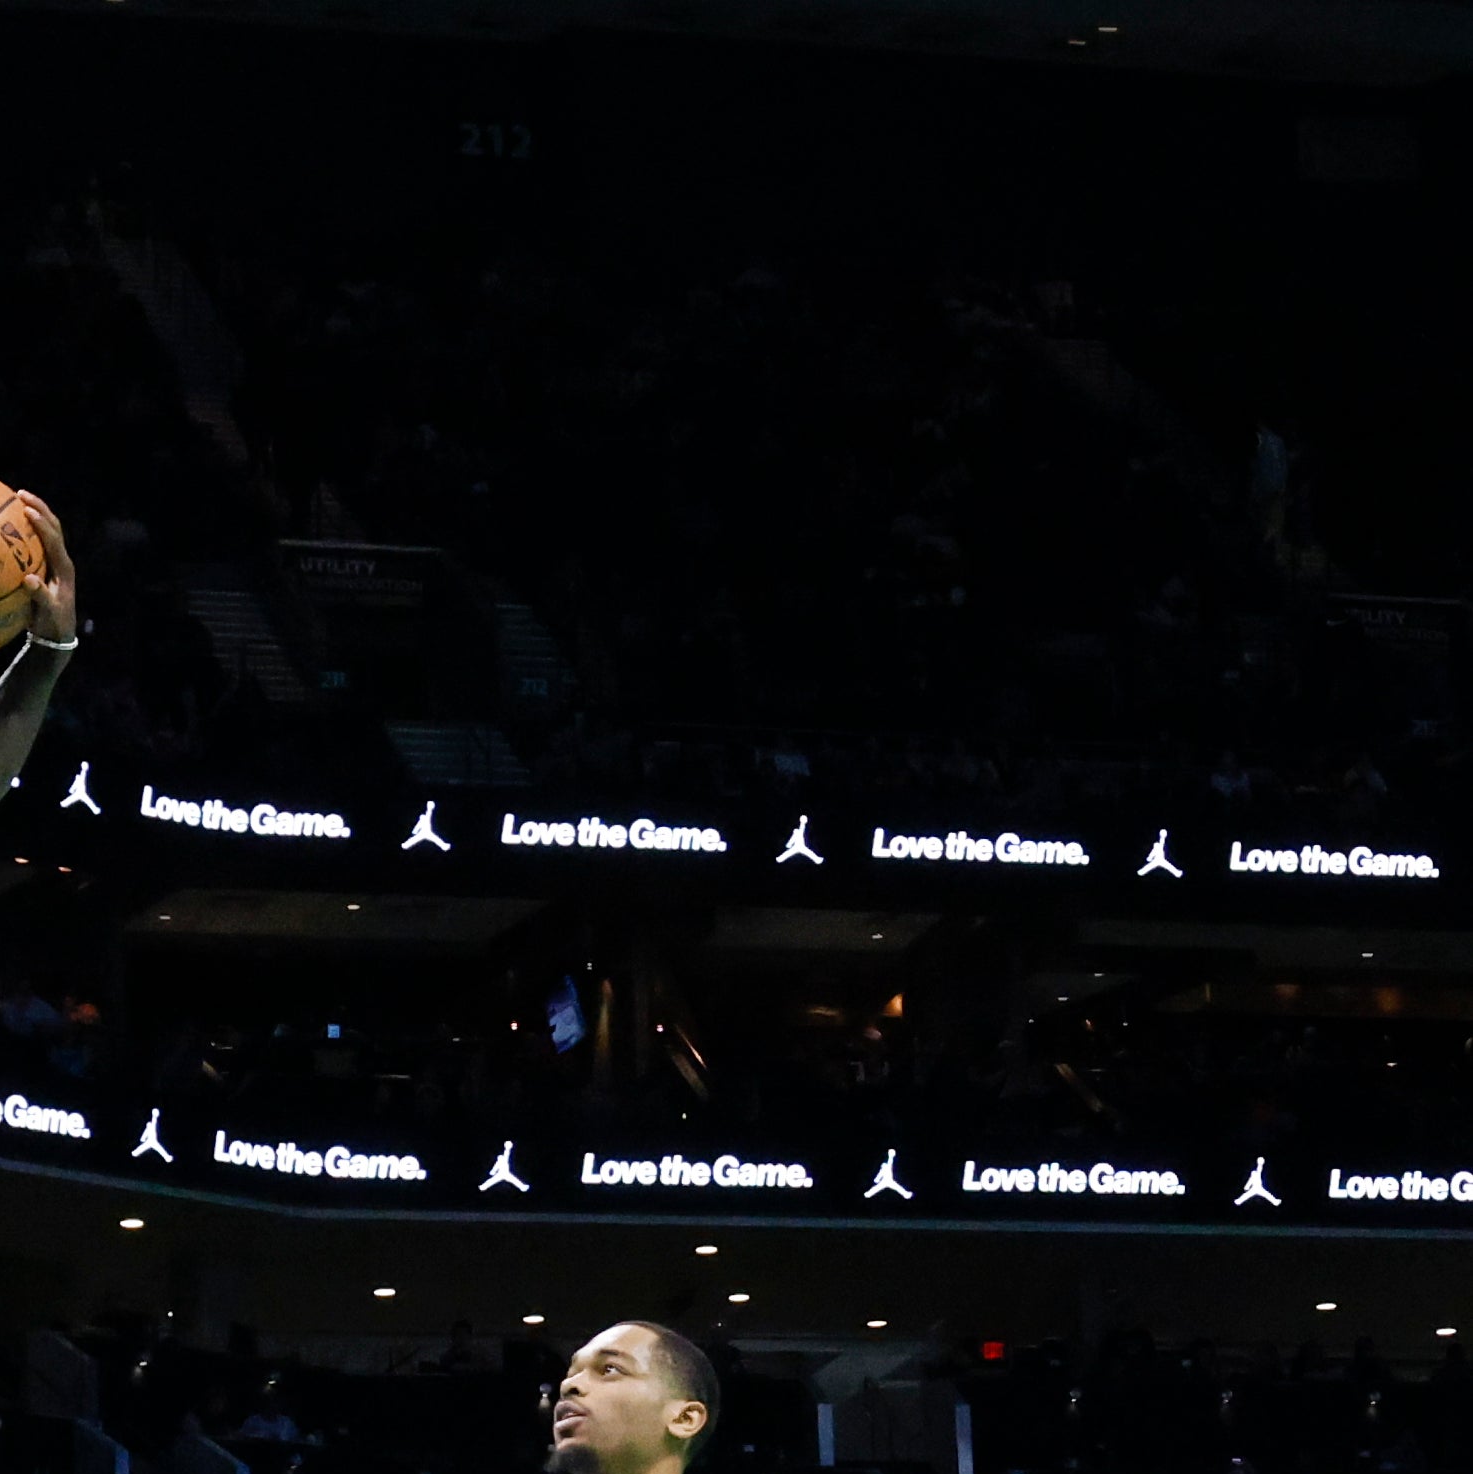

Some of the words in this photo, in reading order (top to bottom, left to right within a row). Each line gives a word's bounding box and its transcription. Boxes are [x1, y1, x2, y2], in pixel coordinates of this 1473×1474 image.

[458, 122, 533, 159] 212
[140, 785, 201, 826] Love
[201, 800, 248, 832] the
[251, 804, 351, 838] Game.
[501, 813, 574, 846] Love
[577, 817, 628, 848] the
[629, 818, 728, 852] Game.
[872, 827, 943, 859] Love
[945, 831, 995, 861] the
[995, 832, 1090, 864] Game.
[1230, 841, 1299, 873] Love
[1299, 844, 1347, 876] the
[1348, 845, 1440, 878] Game.
[4, 1094, 91, 1140] Game.
[213, 1130, 274, 1170] Love
[275, 1142, 323, 1176] the
[324, 1146, 426, 1180] Game.
[581, 1152, 658, 1185] Love
[659, 1154, 712, 1187] the
[712, 1155, 814, 1189] Game.
[962, 1160, 1036, 1192] Love
[1037, 1161, 1088, 1194] the
[1089, 1162, 1186, 1196] Game.
[1328, 1168, 1399, 1200] Love
[1400, 1170, 1449, 1201] the
